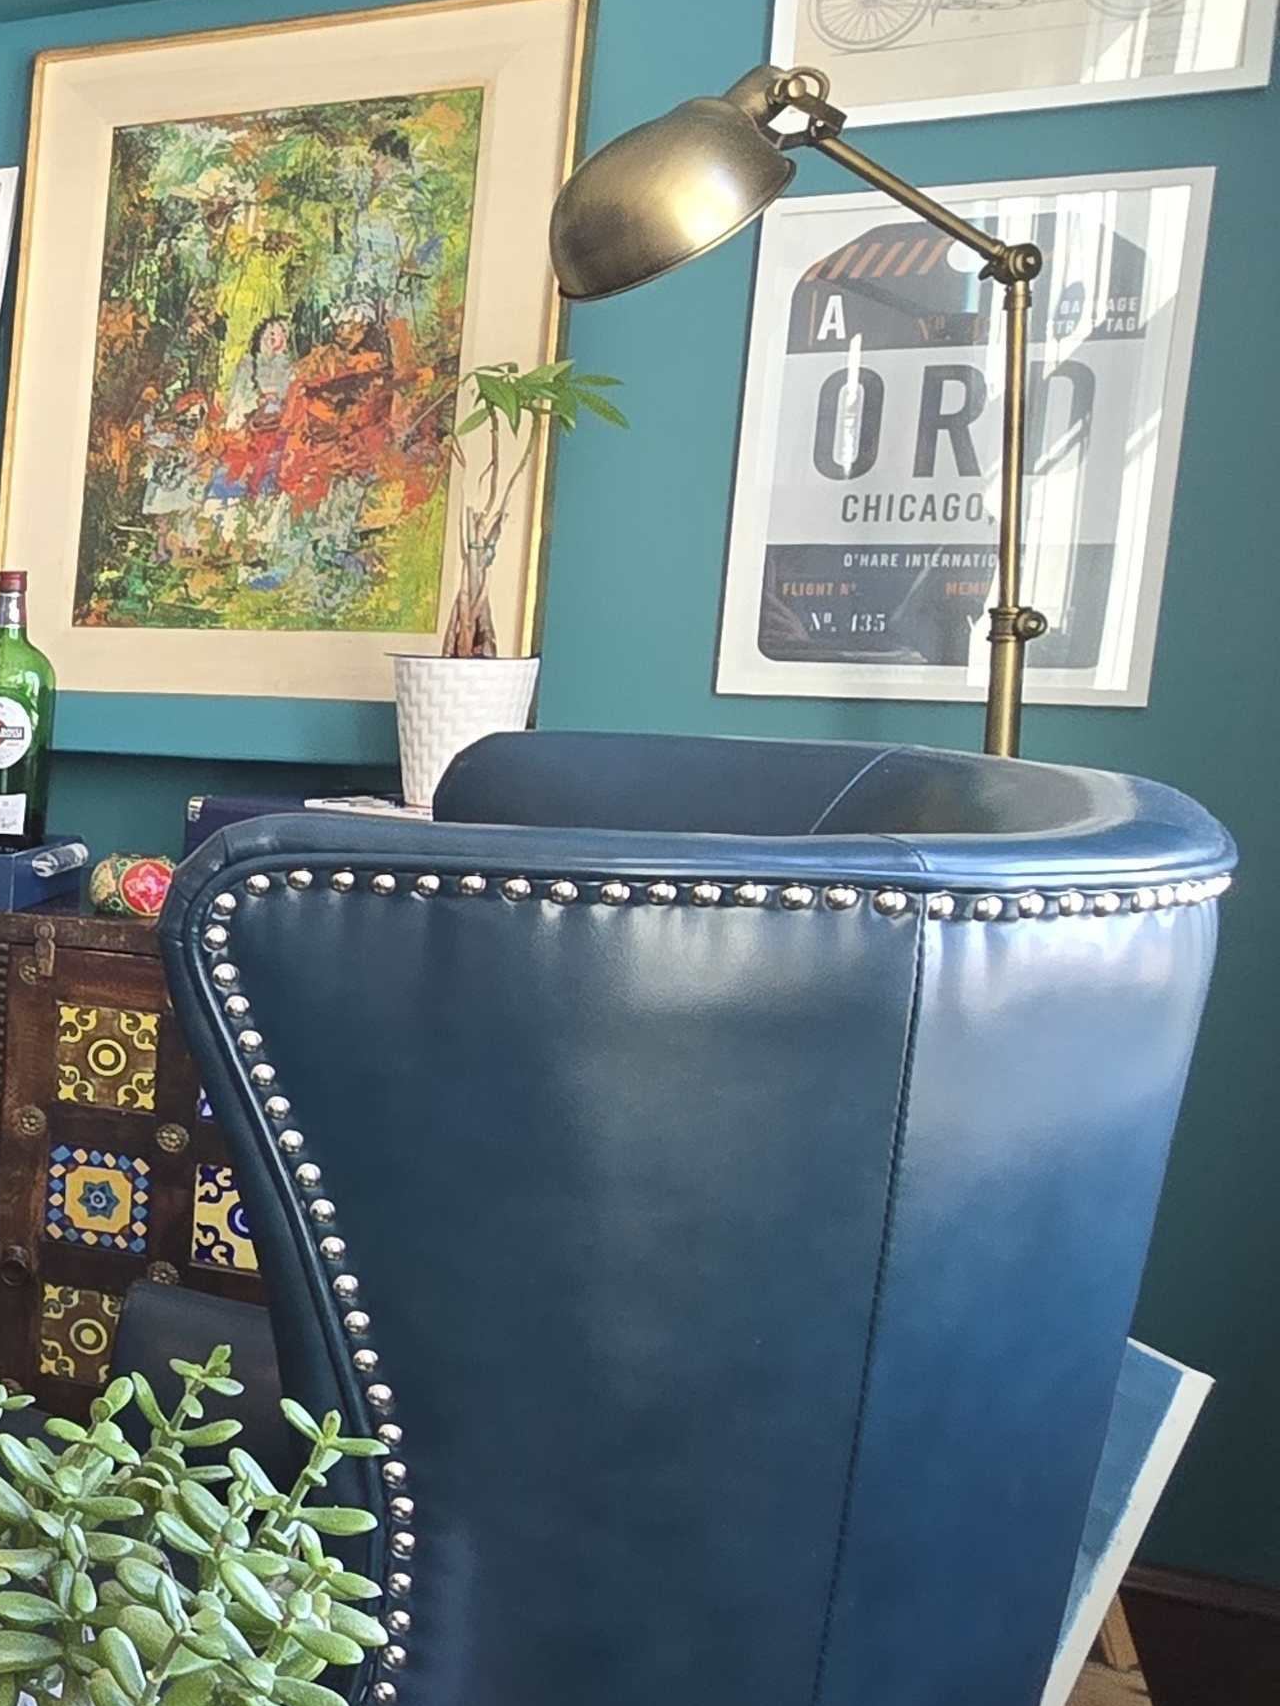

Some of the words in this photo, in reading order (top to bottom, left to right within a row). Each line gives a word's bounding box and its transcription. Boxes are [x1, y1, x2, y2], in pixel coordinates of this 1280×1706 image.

[1059, 296, 1138, 315] BAAGE
[816, 294, 846, 341] A
[1105, 316, 1136, 333] TAG
[813, 359, 1096, 481] ORD
[843, 553, 899, 568] O'HARE
[782, 581, 834, 597] FLIGHT
